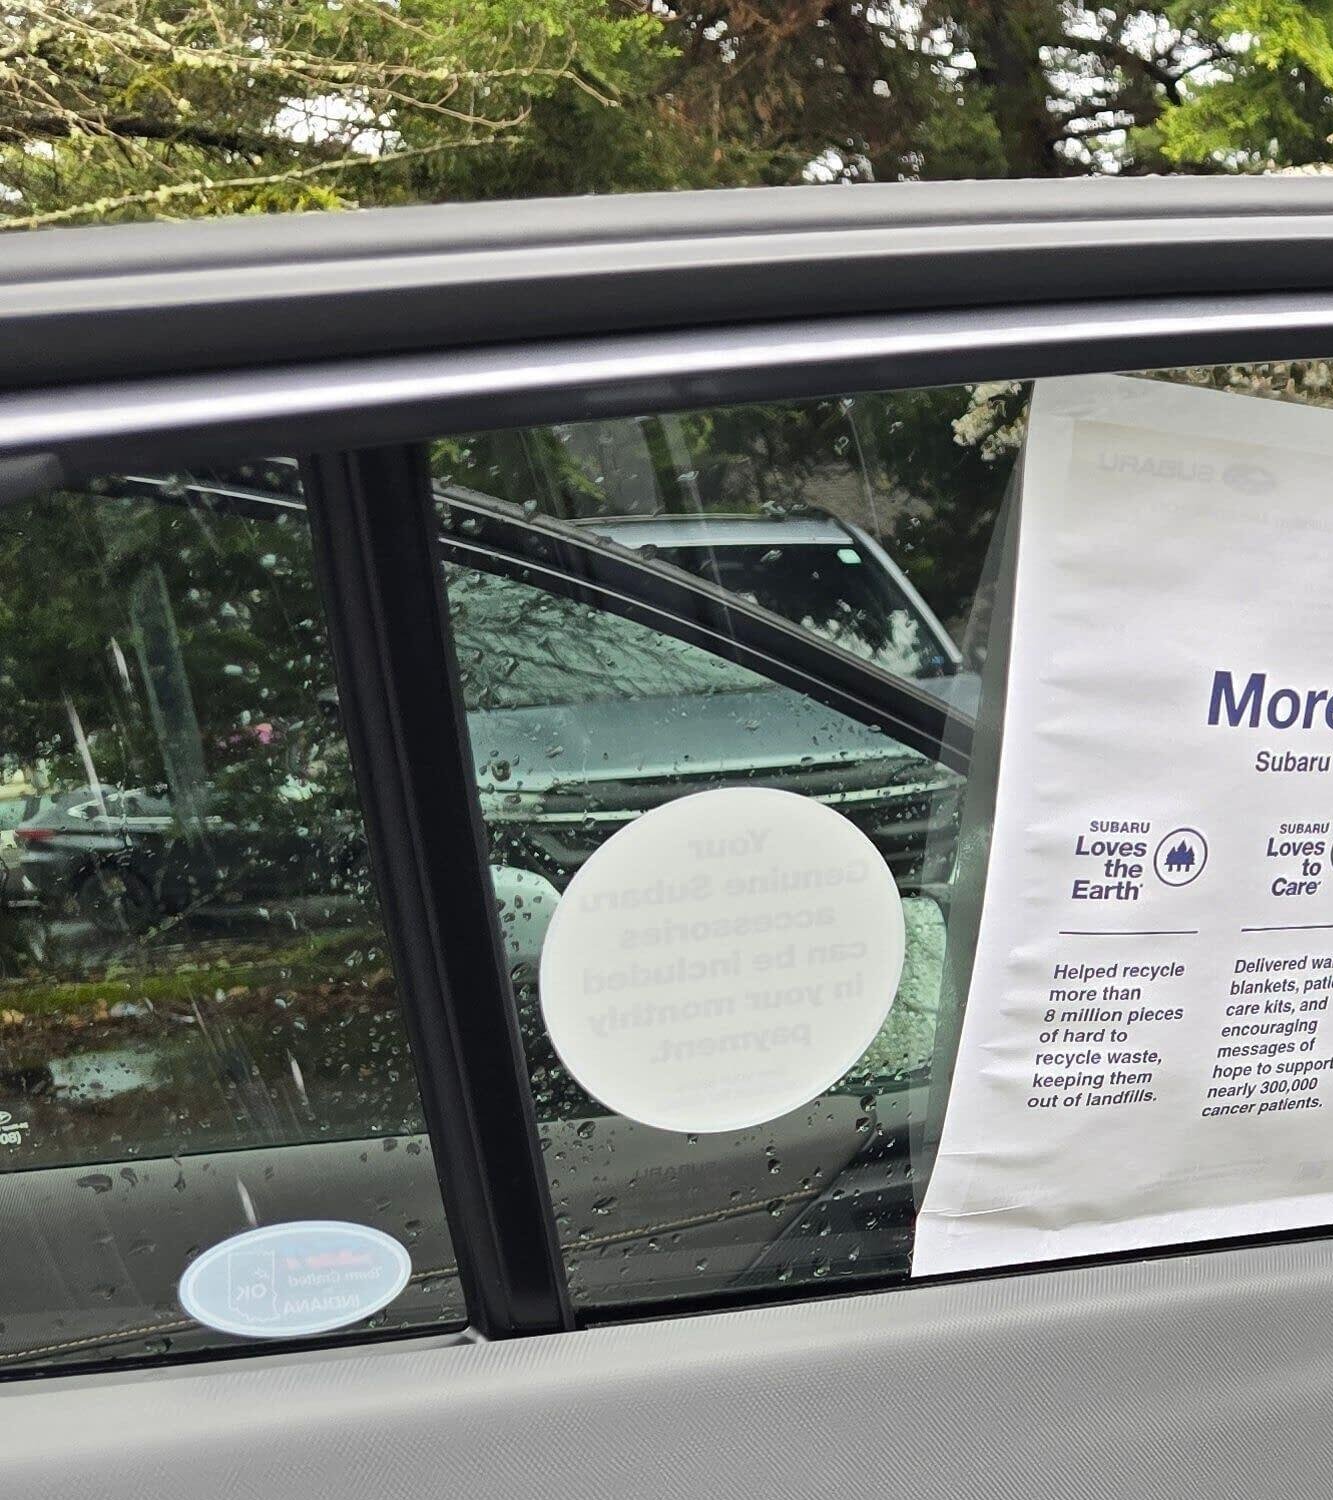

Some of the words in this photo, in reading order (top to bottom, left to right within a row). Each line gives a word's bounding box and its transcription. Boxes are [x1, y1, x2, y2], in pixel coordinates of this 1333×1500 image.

[1255, 751, 1331, 772] Subaru
[1089, 820, 1151, 834] SUBARU
[1279, 822, 1330, 834] SUBARU
[1075, 836, 1147, 858] Loves
[1266, 837, 1325, 858] Loves
[1104, 859, 1143, 879] the
[1302, 858, 1321, 877] to
[1071, 880, 1139, 901] Earth
[1271, 878, 1317, 897] Care
[1053, 964, 1118, 983] Helped
[1122, 962, 1185, 981] recycle
[1234, 955, 1309, 974] Delivered
[1049, 988, 1097, 1001] more
[1102, 986, 1141, 1001] than
[1230, 978, 1300, 996] blankets,
[1226, 1003, 1260, 1016] care
[1264, 999, 1296, 1015] kits,
[1299, 996, 1329, 1012] and
[1044, 1009, 1056, 1022] 8
[1060, 1008, 1123, 1022] million
[1126, 1007, 1184, 1025] pieces
[1039, 1029, 1059, 1043] of
[1063, 1028, 1105, 1043] hard
[1110, 1029, 1128, 1043] to
[1221, 1018, 1318, 1037] encouraging
[1217, 1042, 1296, 1059] messages
[1299, 1037, 1317, 1052] of
[1035, 1050, 1101, 1069] recycle
[1107, 1050, 1162, 1065] waste,
[1032, 1072, 1105, 1090] keeping
[1109, 1071, 1153, 1085] them
[1212, 1064, 1252, 1081] hope
[1256, 1062, 1272, 1075] to
[1207, 1083, 1256, 1099] nearly
[1260, 1077, 1318, 1095] 300,000
[1027, 1094, 1059, 1108] out
[1062, 1093, 1083, 1107] of
[1085, 1089, 1157, 1107] landfills.
[1201, 1103, 1256, 1117] cancer
[1257, 1097, 1323, 1115] patients.
